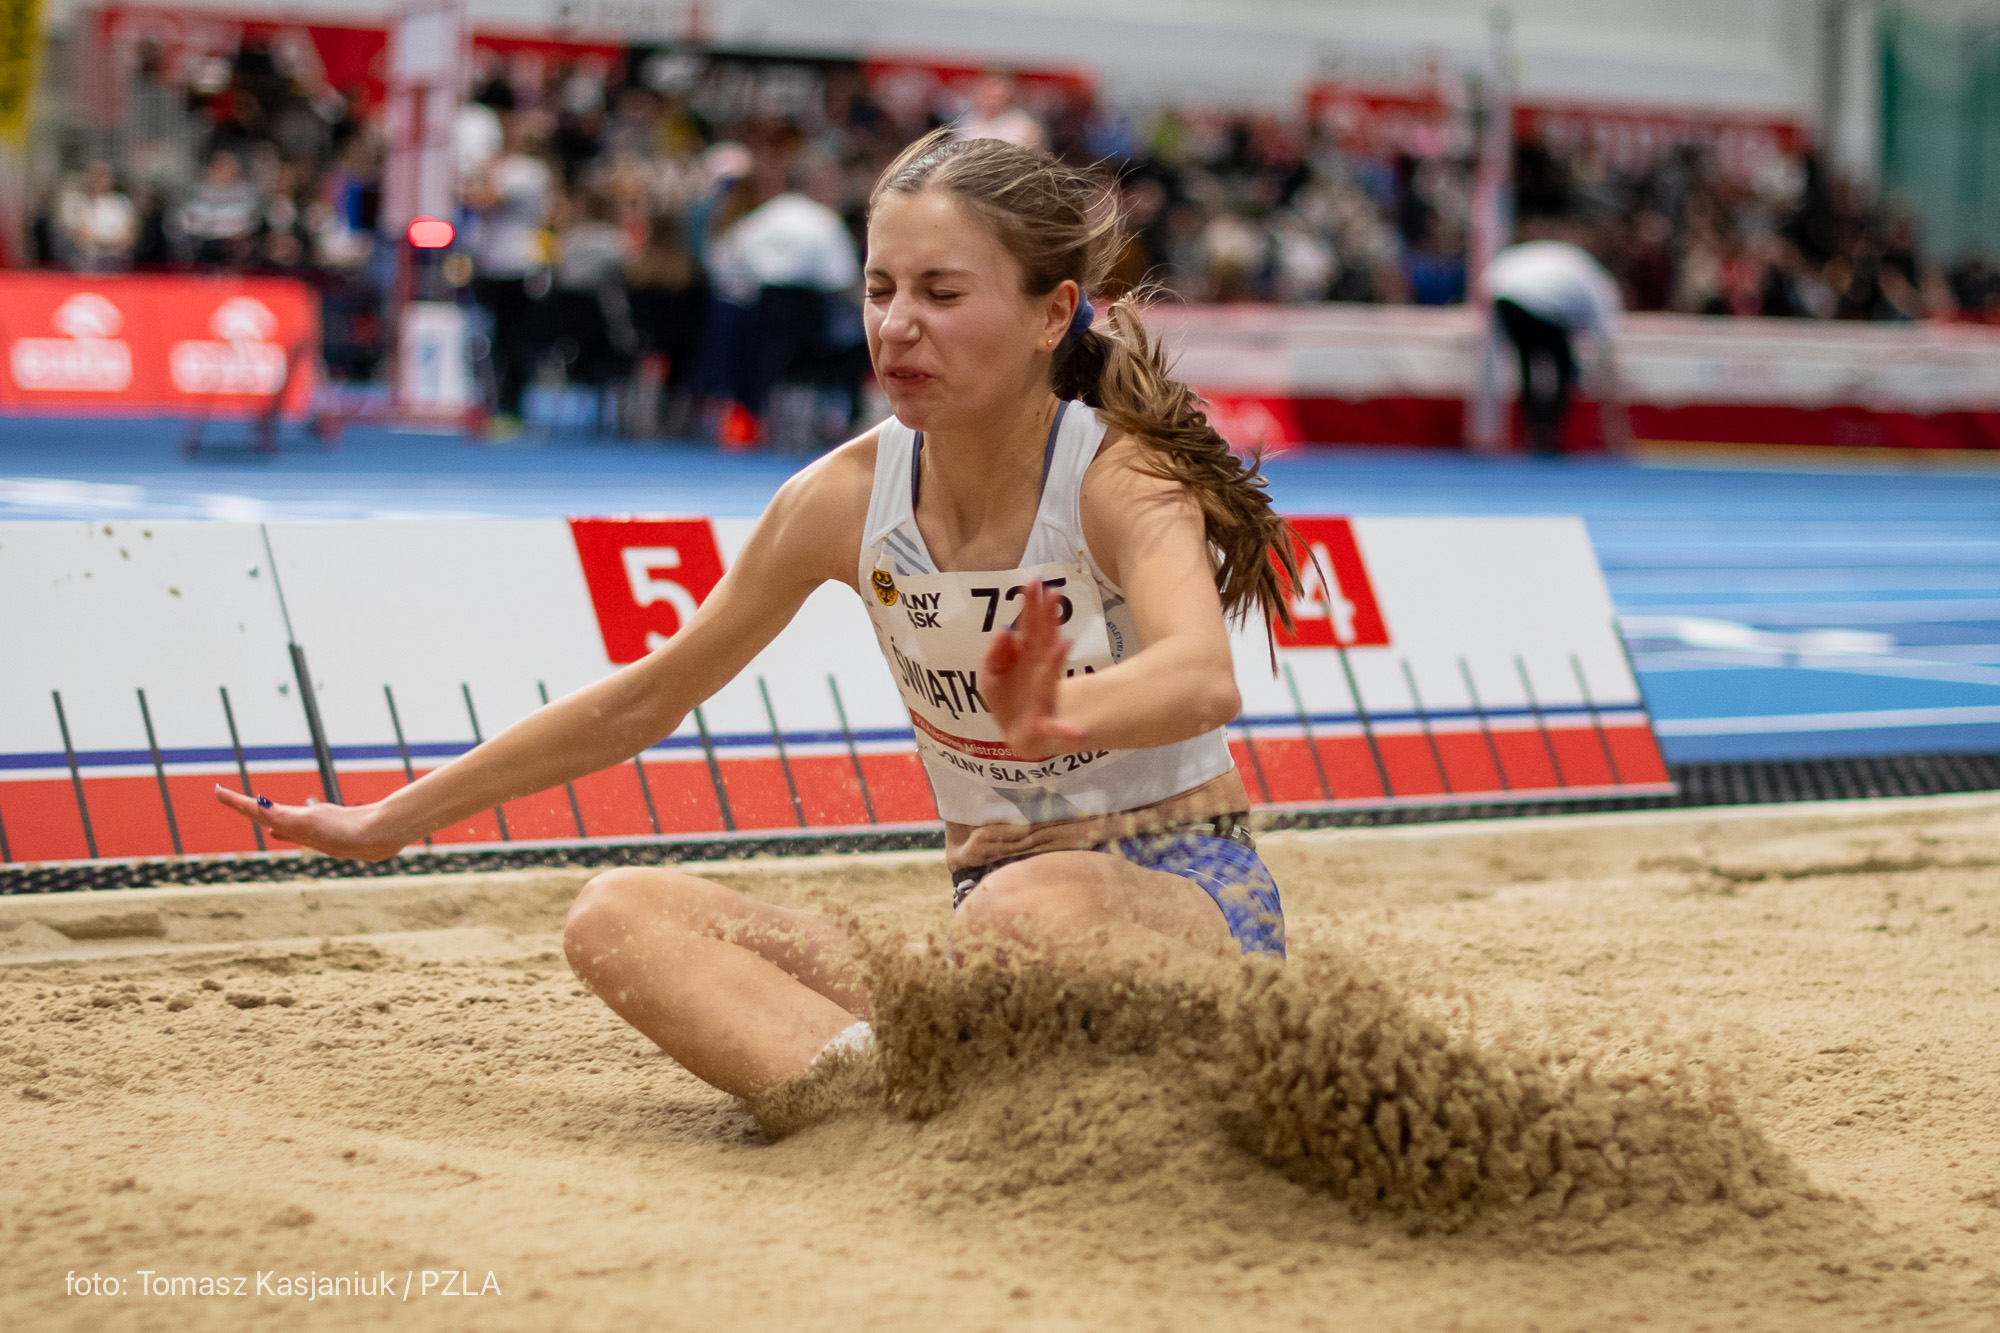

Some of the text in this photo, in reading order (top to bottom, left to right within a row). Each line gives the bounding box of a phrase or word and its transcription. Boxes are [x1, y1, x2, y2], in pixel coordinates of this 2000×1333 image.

[620, 546, 701, 652] 5
[970, 577, 1073, 632] 725
[1291, 541, 1356, 643] 4
[1106, 621, 1124, 652] ATLETYKI
[989, 762, 1062, 784] ŚLĄSK
